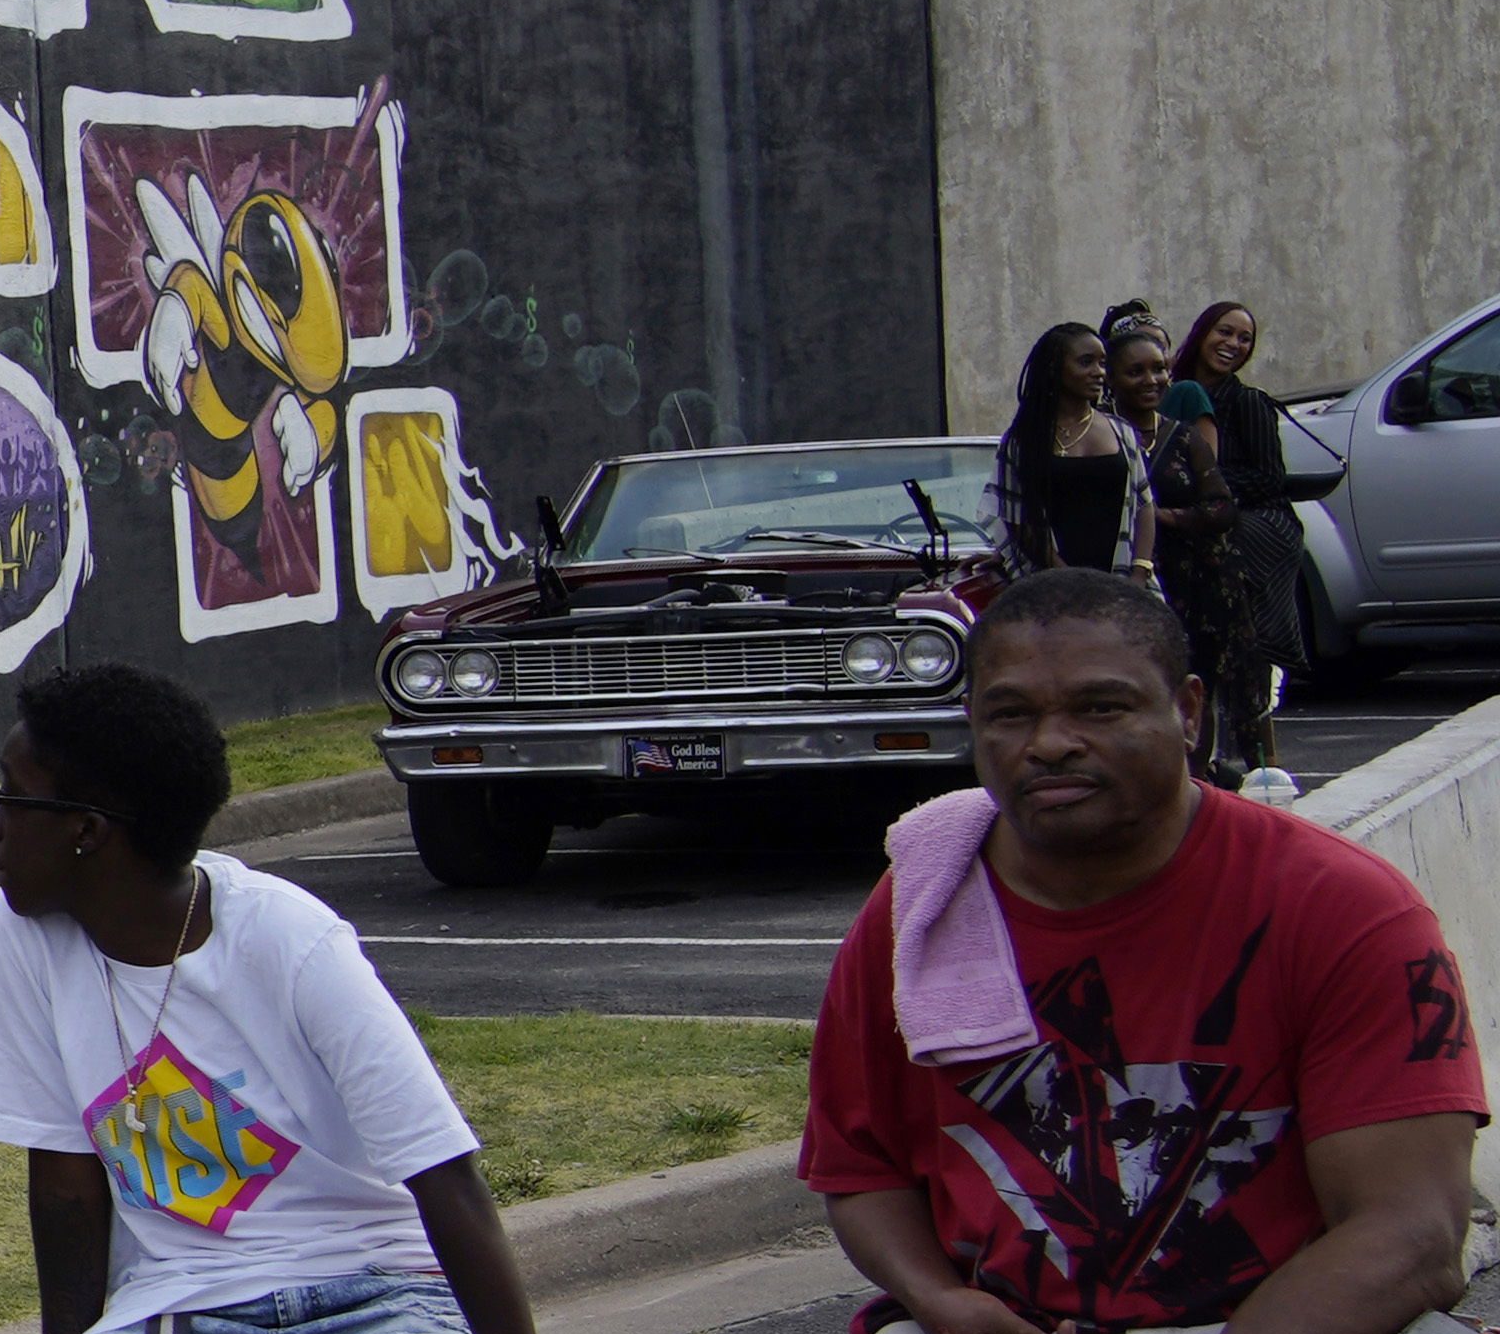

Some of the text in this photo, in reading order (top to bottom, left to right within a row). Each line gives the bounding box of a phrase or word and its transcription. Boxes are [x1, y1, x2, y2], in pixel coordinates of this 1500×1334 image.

[671, 743, 721, 757] God Bless
[675, 758, 718, 771] America
[90, 1069, 276, 1211] RISE
